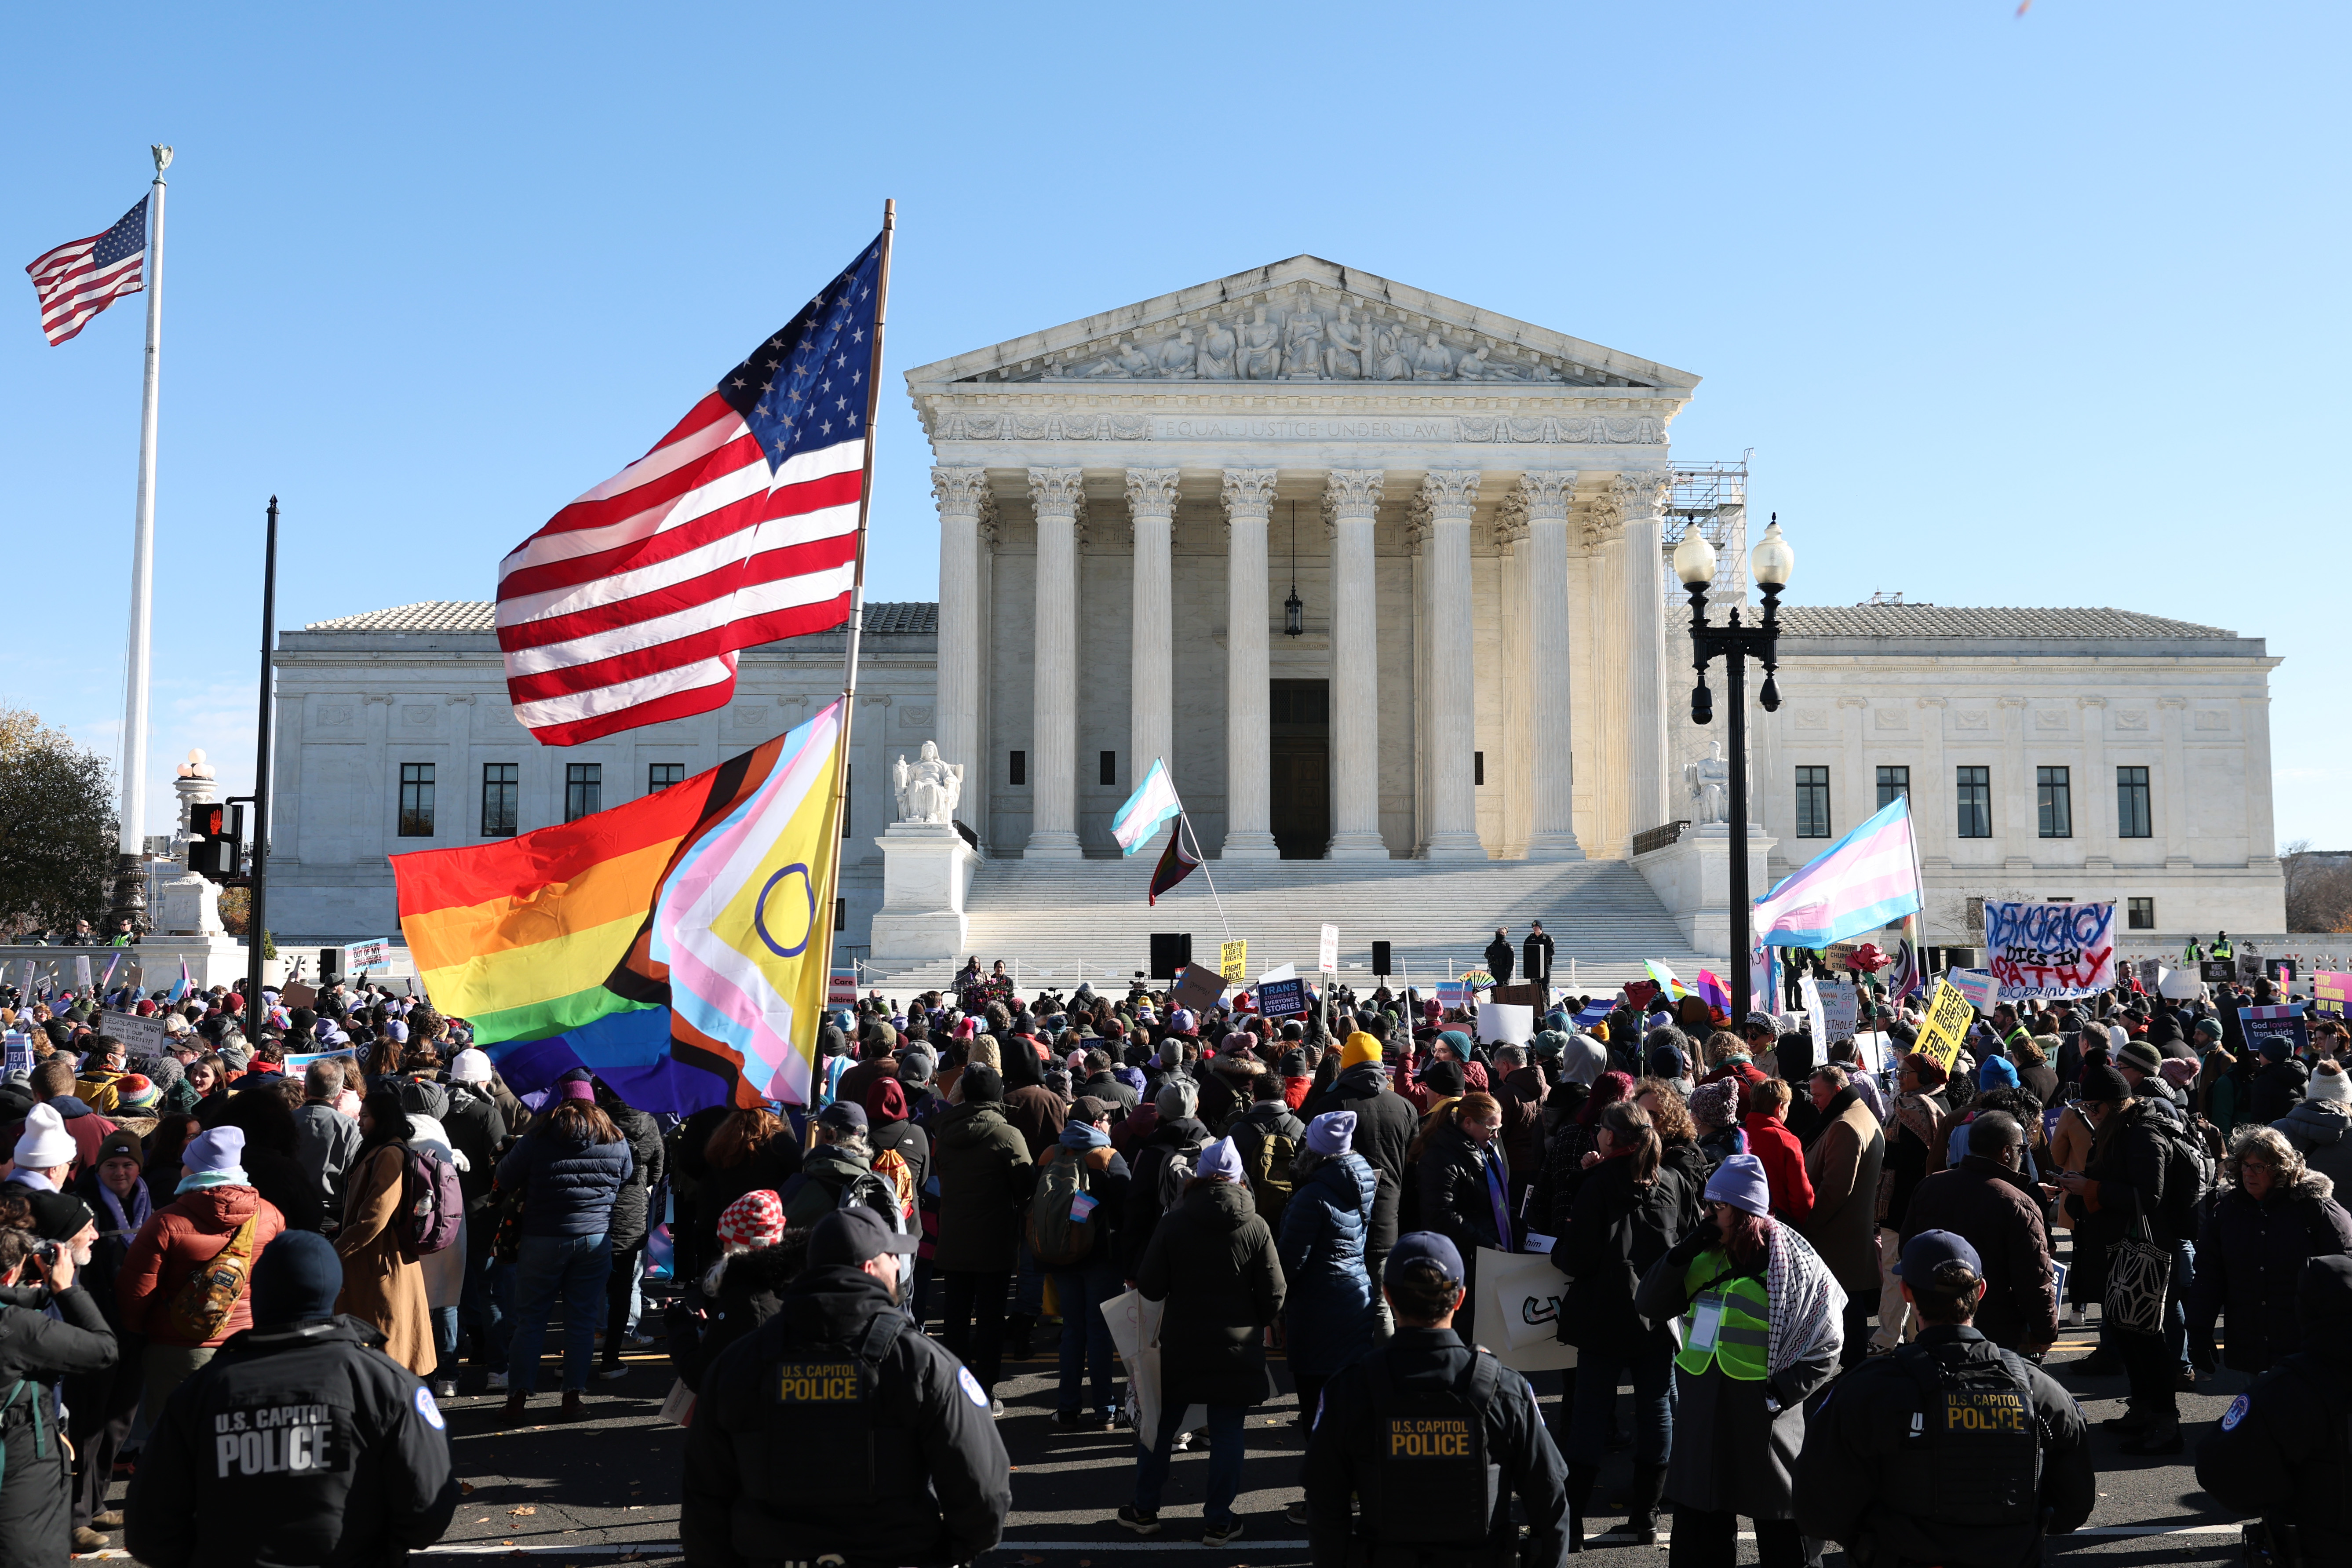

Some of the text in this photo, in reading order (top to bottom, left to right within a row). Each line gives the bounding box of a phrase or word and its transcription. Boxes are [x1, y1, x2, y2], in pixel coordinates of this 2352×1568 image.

[1166, 421, 1440, 438] EQUAL JUSTICE UNDER LAW
[1327, 929, 1332, 937] NO
[1985, 903, 2113, 954] DEMOCRACY
[1224, 941, 1243, 950] DEFEND
[1323, 937, 1336, 948] PARKING
[1225, 954, 1242, 962] RIGHTS
[1226, 948, 1242, 956] LGBTQ
[2005, 945, 2081, 966] DIES IN
[355, 959, 382, 968] APPOINTMENTS
[1225, 963, 1241, 973] FIGHT
[1991, 946, 2112, 988] APATHY
[1223, 970, 1241, 980] BACK!
[2316, 974, 2330, 986] STOP
[1263, 983, 1298, 995] TRANS
[2316, 986, 2345, 1000] TRANSING
[1265, 996, 1299, 1006] EVERYONE'S
[1841, 992, 1856, 1001] GET
[1942, 984, 1970, 1018] DEFEND
[1265, 1002, 1301, 1013] STORIES
[2317, 999, 2344, 1013] GAY KIDS
[1940, 999, 1963, 1030] LGBTQ
[105, 1017, 160, 1034] LEGISLATE HARM
[1826, 1019, 1853, 1030] ITHOLE
[1933, 1009, 1959, 1041] RIGHTS
[111, 1032, 153, 1046] CHILDREN?!?
[1925, 1029, 1952, 1061] FIGHT
[783, 1364, 857, 1378] U.S. CAPITOL
[781, 1378, 857, 1400] POLICE
[1948, 1394, 2022, 1407] U.S. CAPITOL
[215, 1404, 332, 1433] U.S. CAPITOL
[1948, 1407, 2024, 1430] POLICE
[1392, 1421, 1469, 1433] U.S. CAPITOL
[216, 1425, 332, 1478] POLICE
[1392, 1434, 1470, 1456] POLICE
